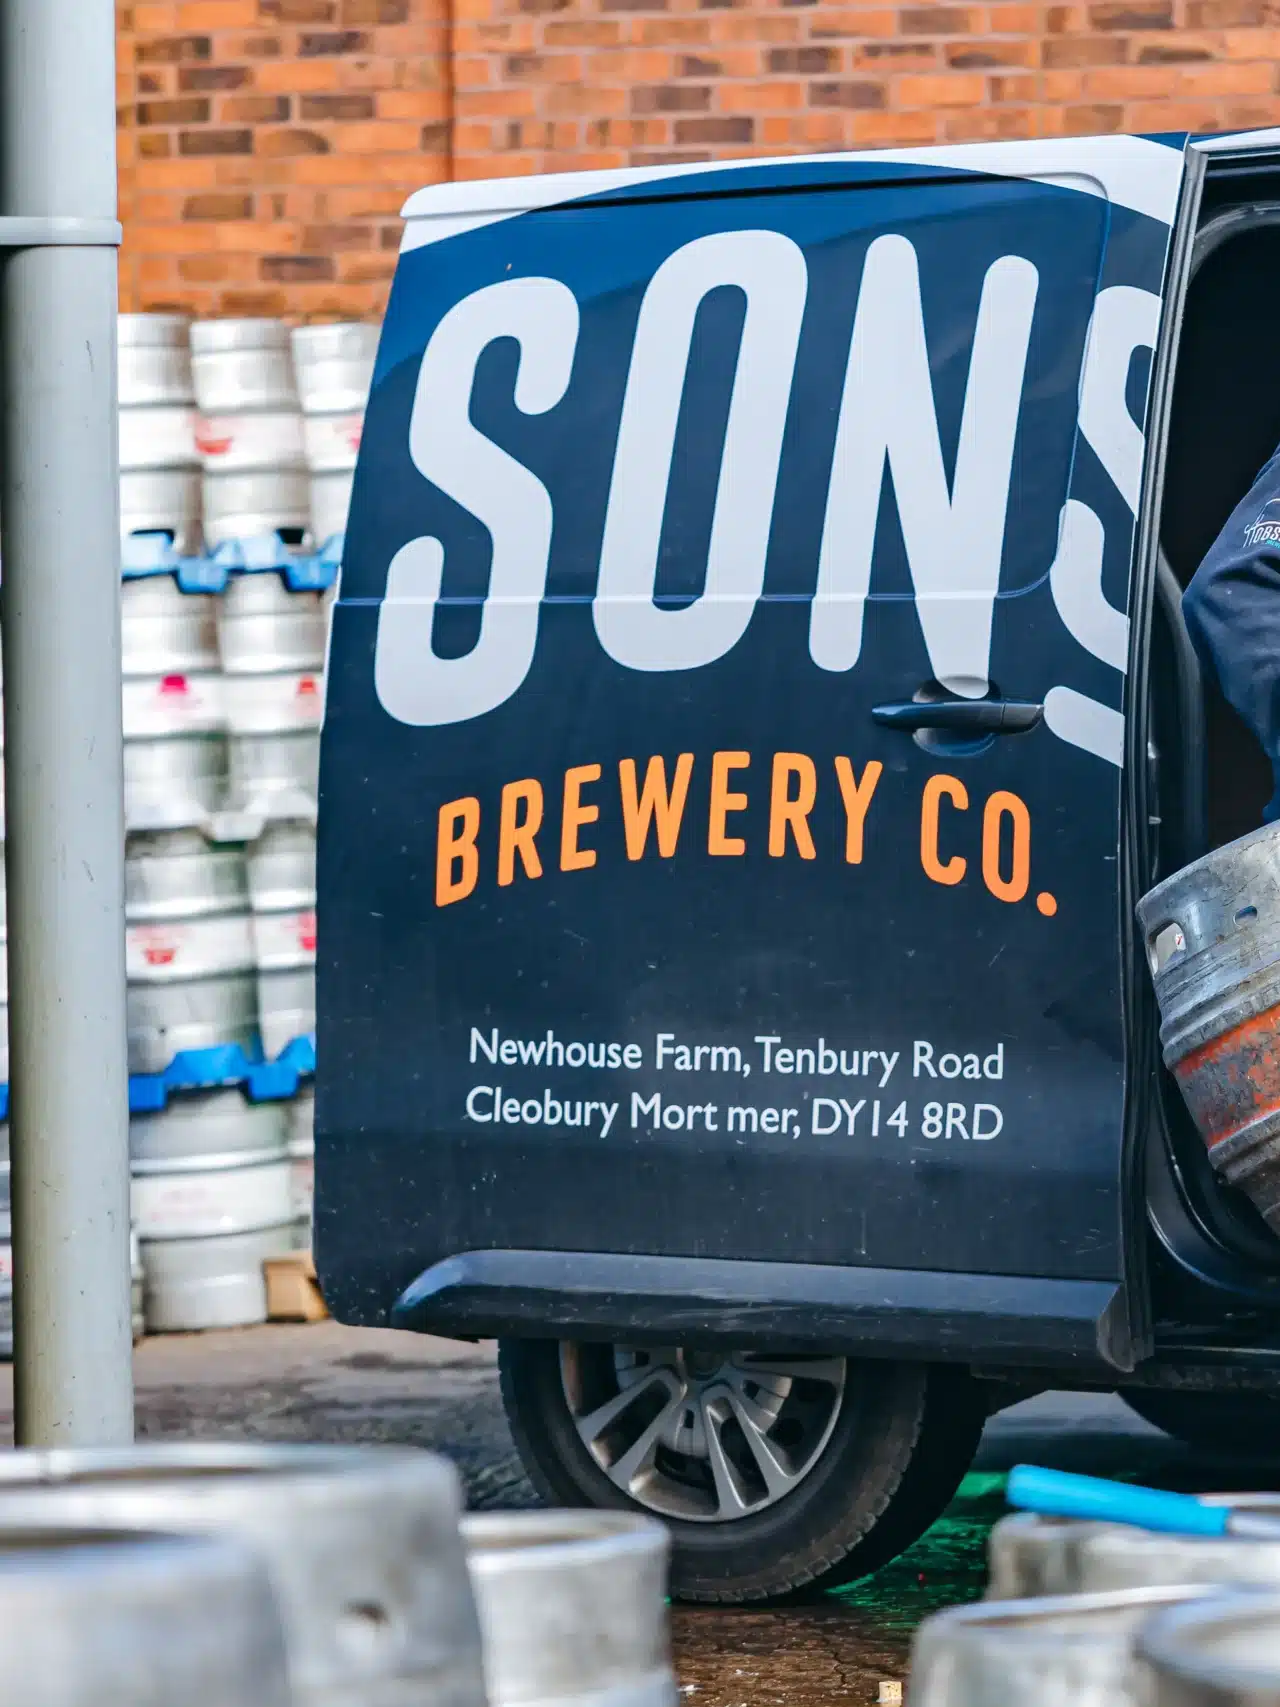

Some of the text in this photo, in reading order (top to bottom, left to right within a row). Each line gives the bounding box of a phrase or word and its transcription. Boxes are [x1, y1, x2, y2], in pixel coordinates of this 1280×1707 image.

[435, 750, 1057, 917] BREWERY CO.
[469, 1027, 1004, 1088] Newhouse Farm, Tenbury Road
[466, 1085, 619, 1139] Cleobury
[811, 1097, 909, 1138] DY14
[921, 1101, 1004, 1141] 8RD
